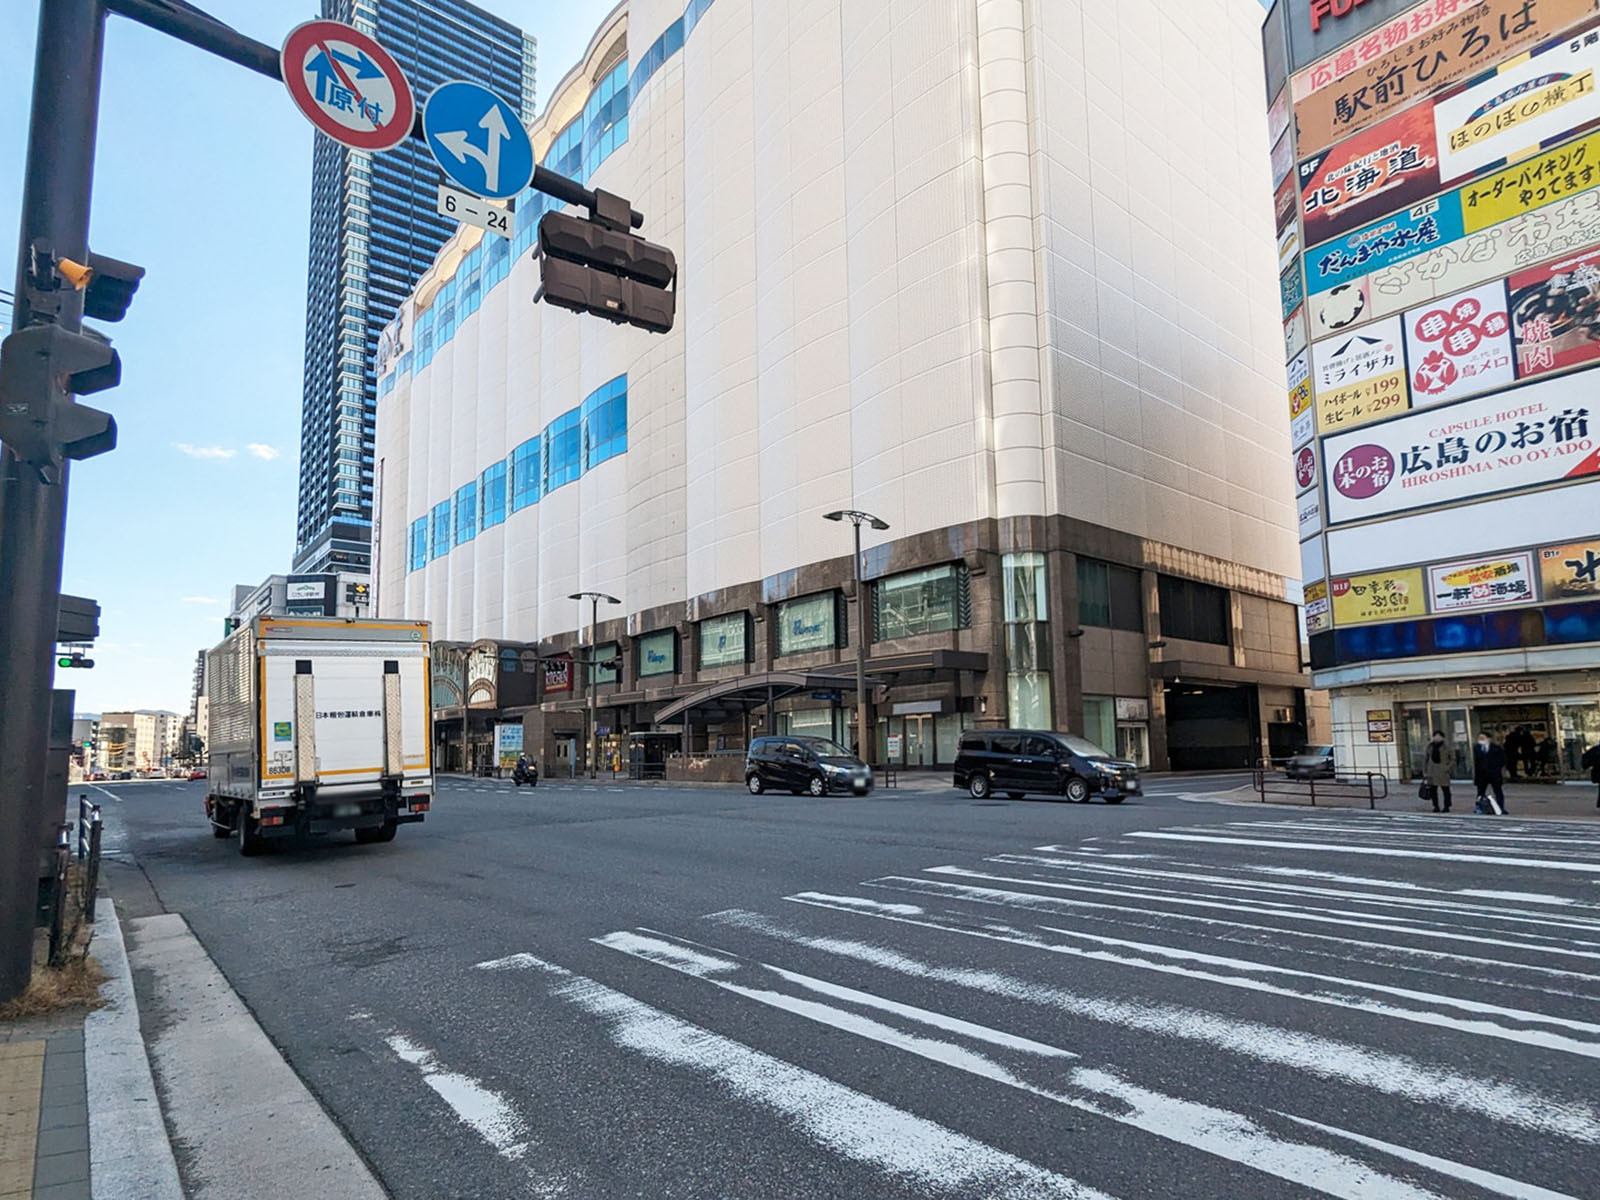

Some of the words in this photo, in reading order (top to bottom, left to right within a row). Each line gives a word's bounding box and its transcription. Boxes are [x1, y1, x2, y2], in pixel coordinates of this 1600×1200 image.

[328, 83, 383, 124] 原付
[1301, 159, 1319, 176] 5F
[1305, 147, 1426, 213] 北海道
[1468, 143, 1587, 207] オーダーバイキング
[1412, 201, 1437, 218] 4F
[1319, 216, 1440, 275] だんまや水産
[1521, 317, 1554, 374] 焼肉
[1324, 354, 1394, 385] ミライザカ
[1324, 389, 1362, 407] ハイボール
[1325, 404, 1363, 425] 生ビール
[1428, 415, 1492, 439] CAPSULE
[1496, 402, 1548, 422] HOTEL
[1400, 408, 1590, 477] 広島のお宿
[1402, 461, 1493, 488] HIROSHIMA
[1497, 453, 1523, 467] NO
[1526, 439, 1593, 462] OYADO
[1470, 685, 1496, 695] FULL
[1500, 682, 1538, 694] FOCUS
